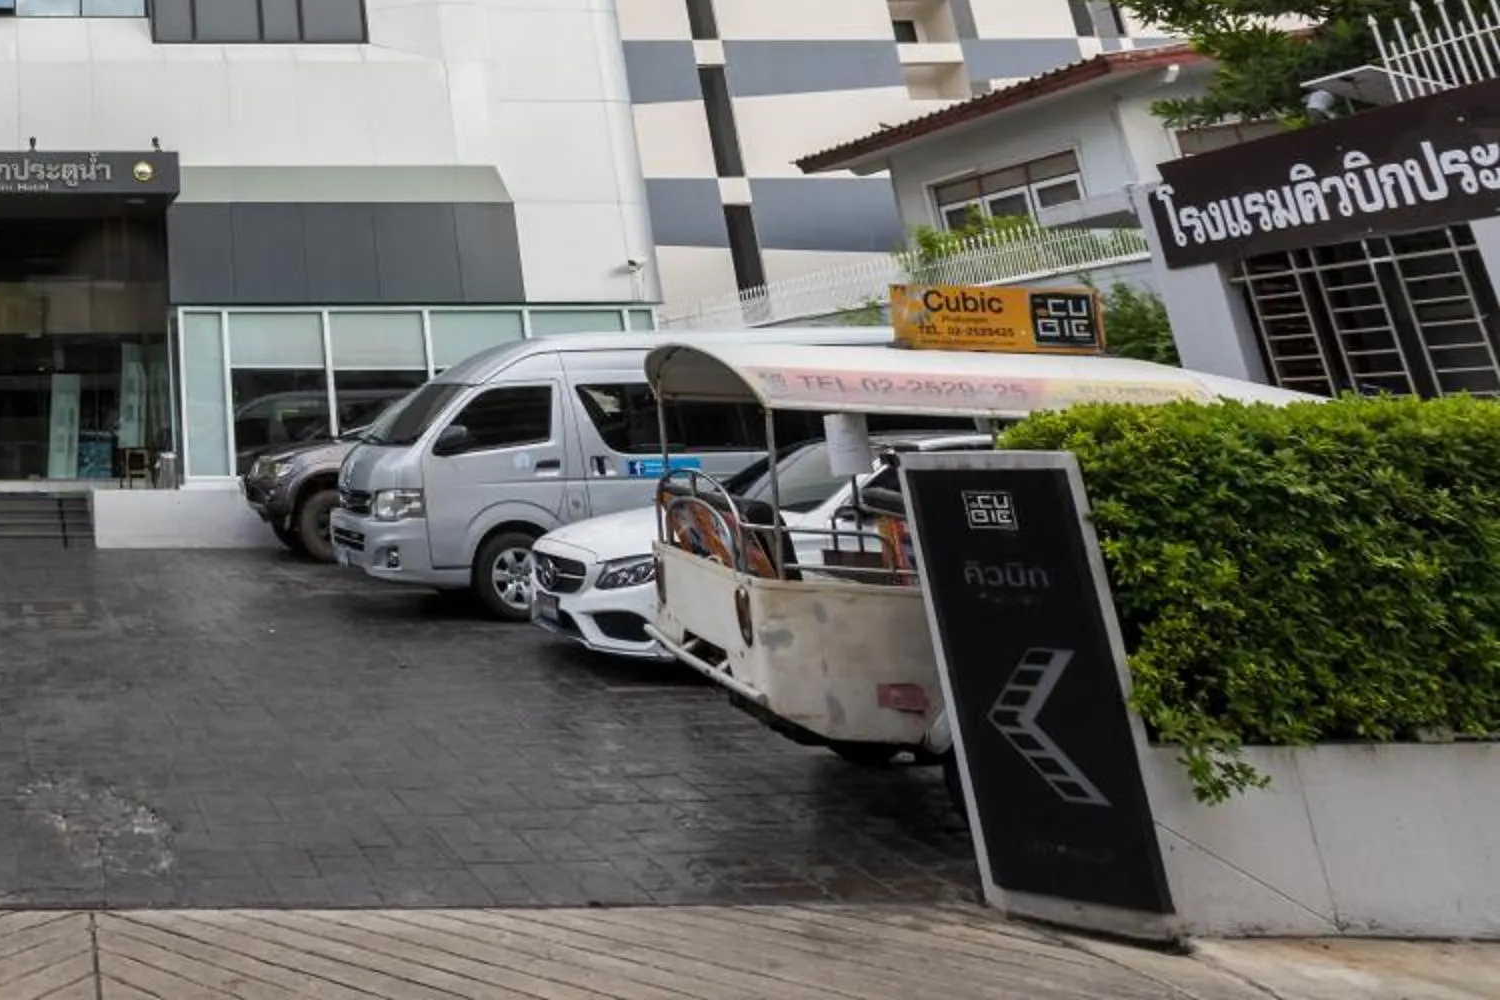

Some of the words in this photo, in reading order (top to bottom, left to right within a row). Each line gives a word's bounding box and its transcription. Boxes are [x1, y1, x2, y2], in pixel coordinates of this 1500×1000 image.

[923, 289, 1004, 313] Cubic
[964, 560, 1050, 589] คิวบิก
